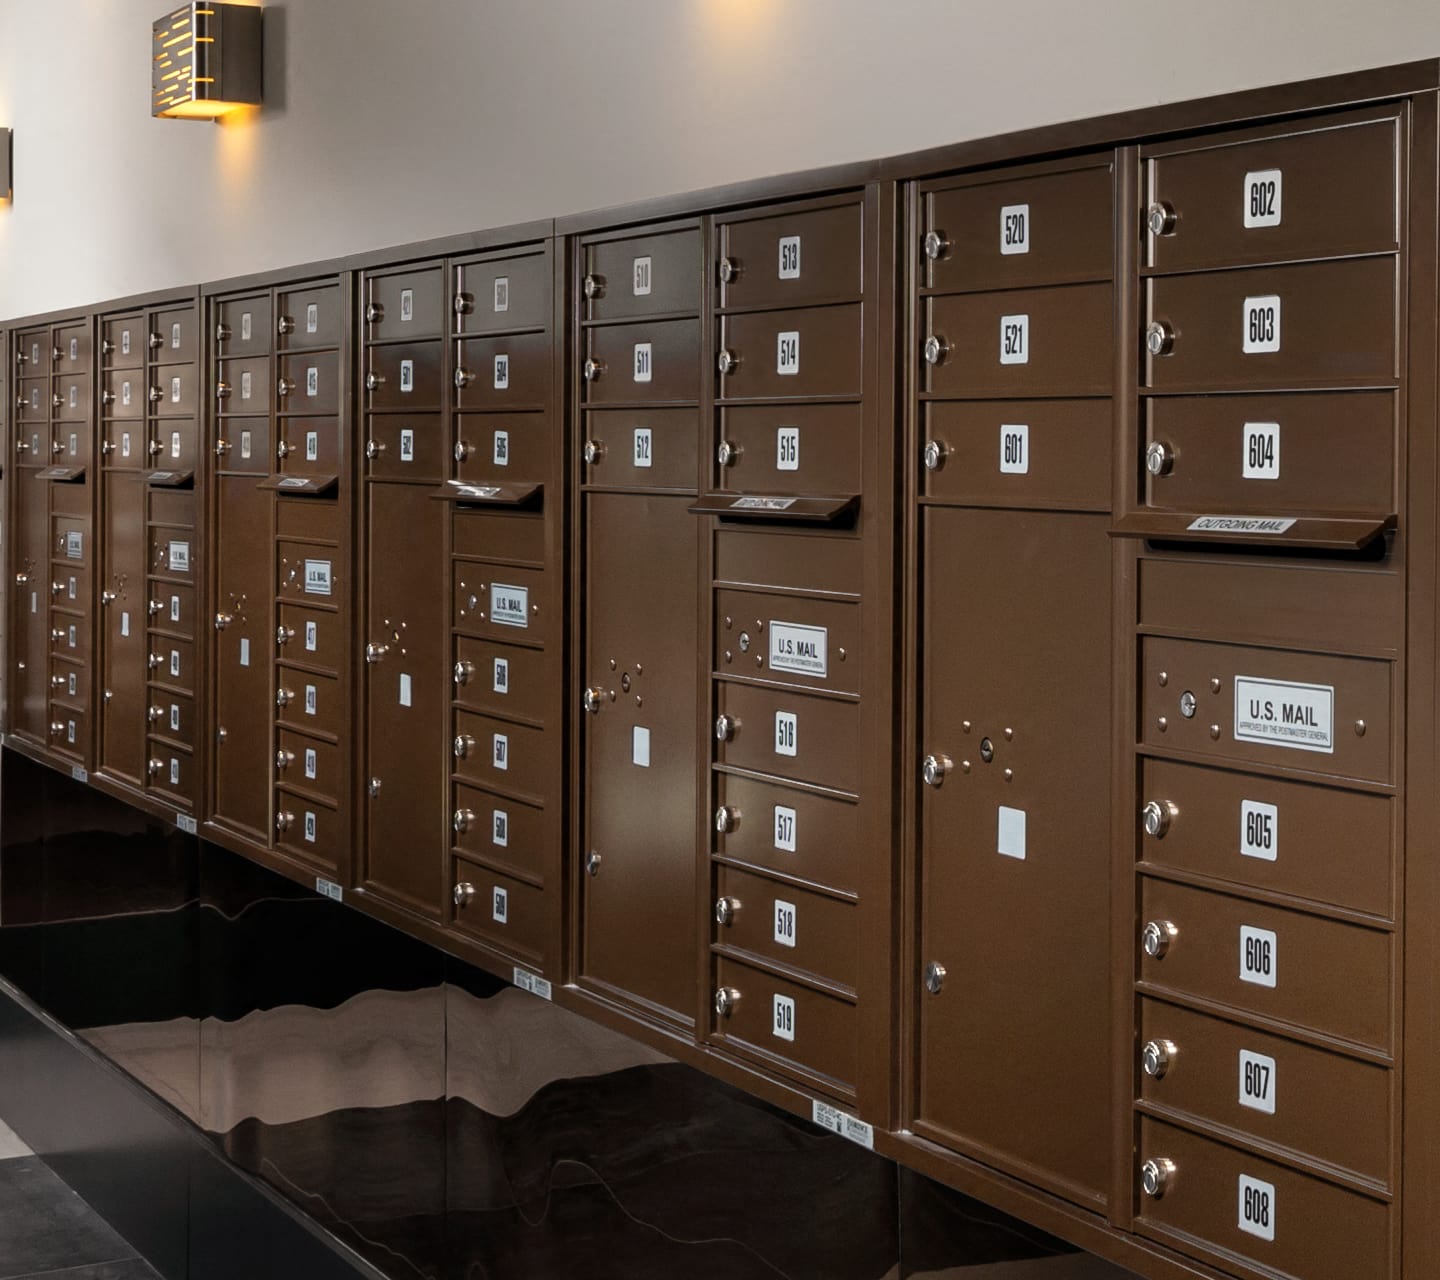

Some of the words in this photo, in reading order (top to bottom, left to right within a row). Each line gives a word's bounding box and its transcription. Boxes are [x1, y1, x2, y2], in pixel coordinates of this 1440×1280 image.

[1250, 180, 1276, 218] 602
[1005, 212, 1025, 246] 520
[782, 242, 798, 272] 513
[635, 263, 649, 289] 510
[1004, 323, 1023, 356] 521
[1249, 306, 1275, 344] 603
[636, 350, 649, 375] 511
[780, 338, 797, 367] 514
[496, 360, 507, 383] 504
[636, 434, 650, 460] 512
[780, 435, 797, 463] 515
[1004, 432, 1023, 465] 601
[1248, 433, 1275, 469] 604
[1198, 519, 1258, 530] OUTGOING
[1256, 521, 1285, 531] MAIL
[778, 638, 795, 655] U.S.
[797, 641, 818, 659] MAIL
[1250, 699, 1277, 722] U.S.
[1282, 703, 1318, 727] MAIL
[778, 719, 794, 748] 516
[495, 739, 506, 763] 507
[777, 813, 793, 843] 517
[1246, 810, 1272, 850] 605
[777, 907, 793, 939] 518
[1245, 936, 1271, 976] 606
[776, 1001, 792, 1033] 519
[1244, 1060, 1270, 1100] 607
[1244, 1185, 1270, 1228] 608
